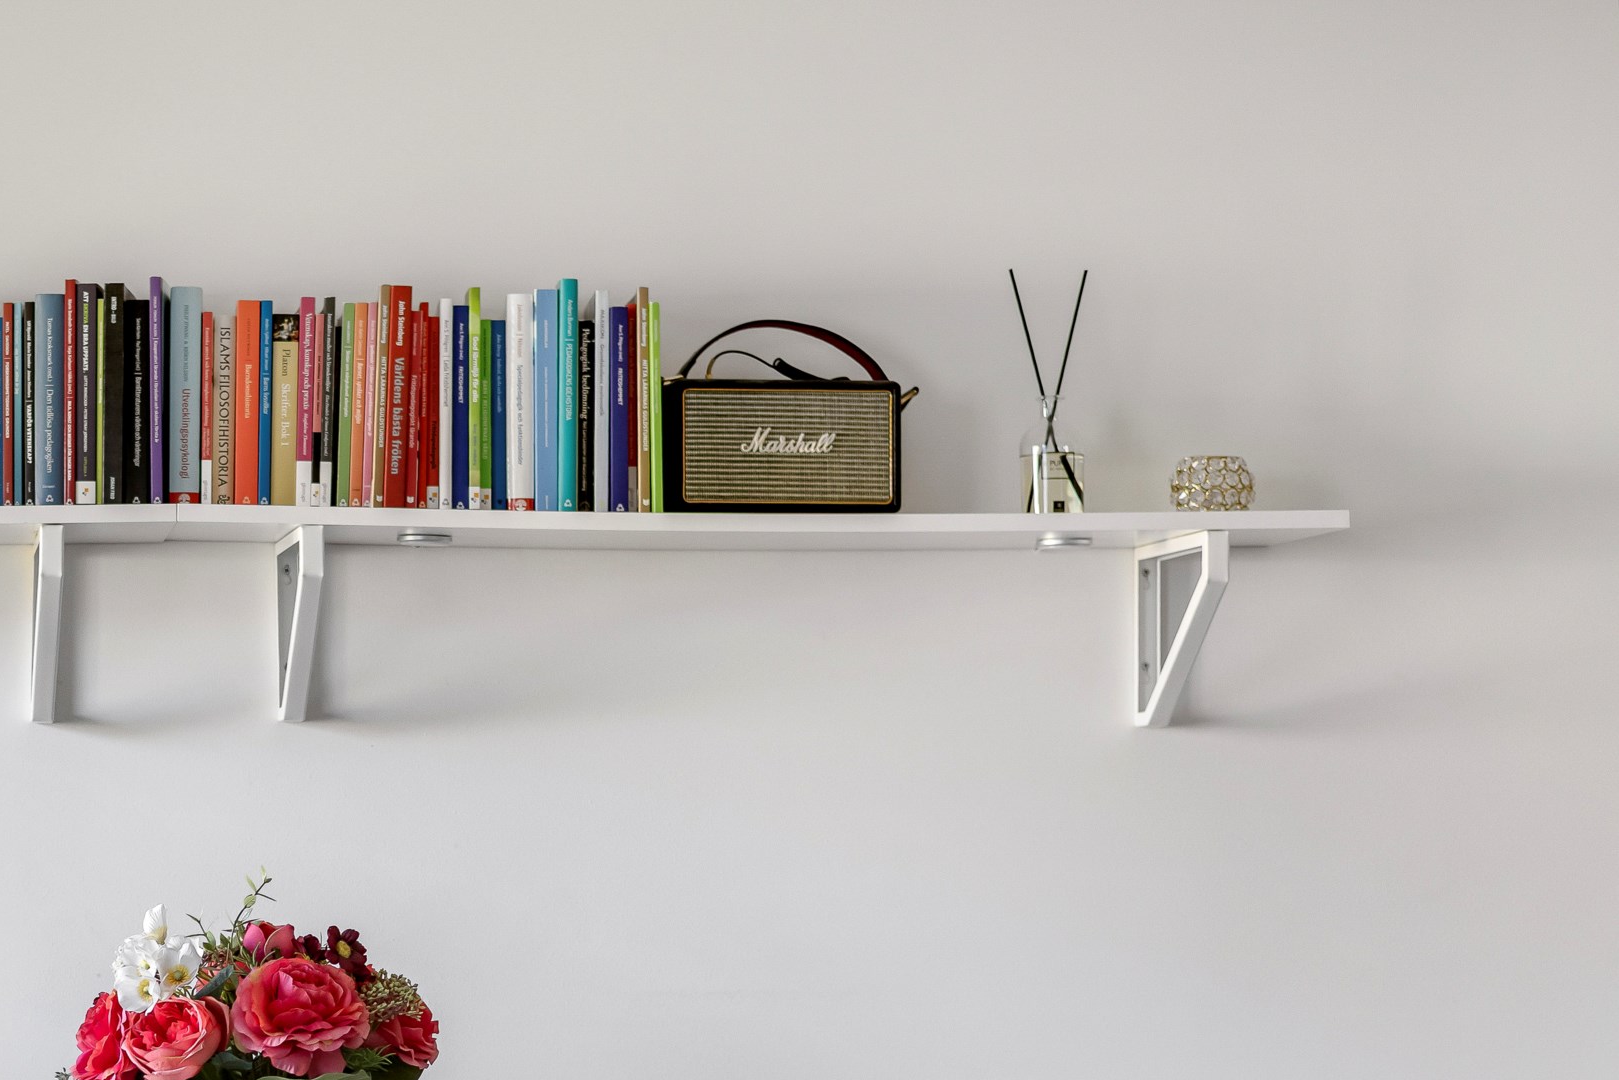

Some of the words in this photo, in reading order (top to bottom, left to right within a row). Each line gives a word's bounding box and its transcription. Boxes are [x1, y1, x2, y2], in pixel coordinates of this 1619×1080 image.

[398, 300, 406, 316] John
[83, 325, 89, 333] EN
[303, 313, 313, 349] Vetenskap,
[380, 318, 388, 344] Steinberg
[396, 316, 405, 346] Steinberg
[219, 327, 231, 371] ISLAMS
[282, 349, 291, 376] Platon
[302, 349, 312, 377] kunskap
[471, 352, 479, 378] lärmiljö
[565, 343, 573, 386] PEDAGOGIKENS
[580, 328, 591, 373] Pedagogisk
[46, 389, 54, 405] Den
[134, 376, 142, 416] Barnlitteraturens
[244, 364, 252, 419] Barndomshistoria
[394, 357, 405, 404] Världens
[516, 365, 524, 411] Specialpedagogik
[580, 375, 591, 419] bedömning
[46, 405, 54, 428] tidlösa
[281, 384, 291, 419] Skrifter.
[302, 390, 310, 410] praxis
[409, 375, 418, 427] Fritidspedagogiskt
[178, 389, 191, 479] Utvecklingspsykologi
[218, 374, 230, 487] FILOSOFIHISTORIA
[281, 421, 290, 439] Bok
[392, 407, 403, 437] bästa
[45, 429, 54, 473] pedagogiken
[133, 441, 141, 467] värderingar
[391, 440, 402, 475] fröken
[741, 427, 836, 453] Marshall
